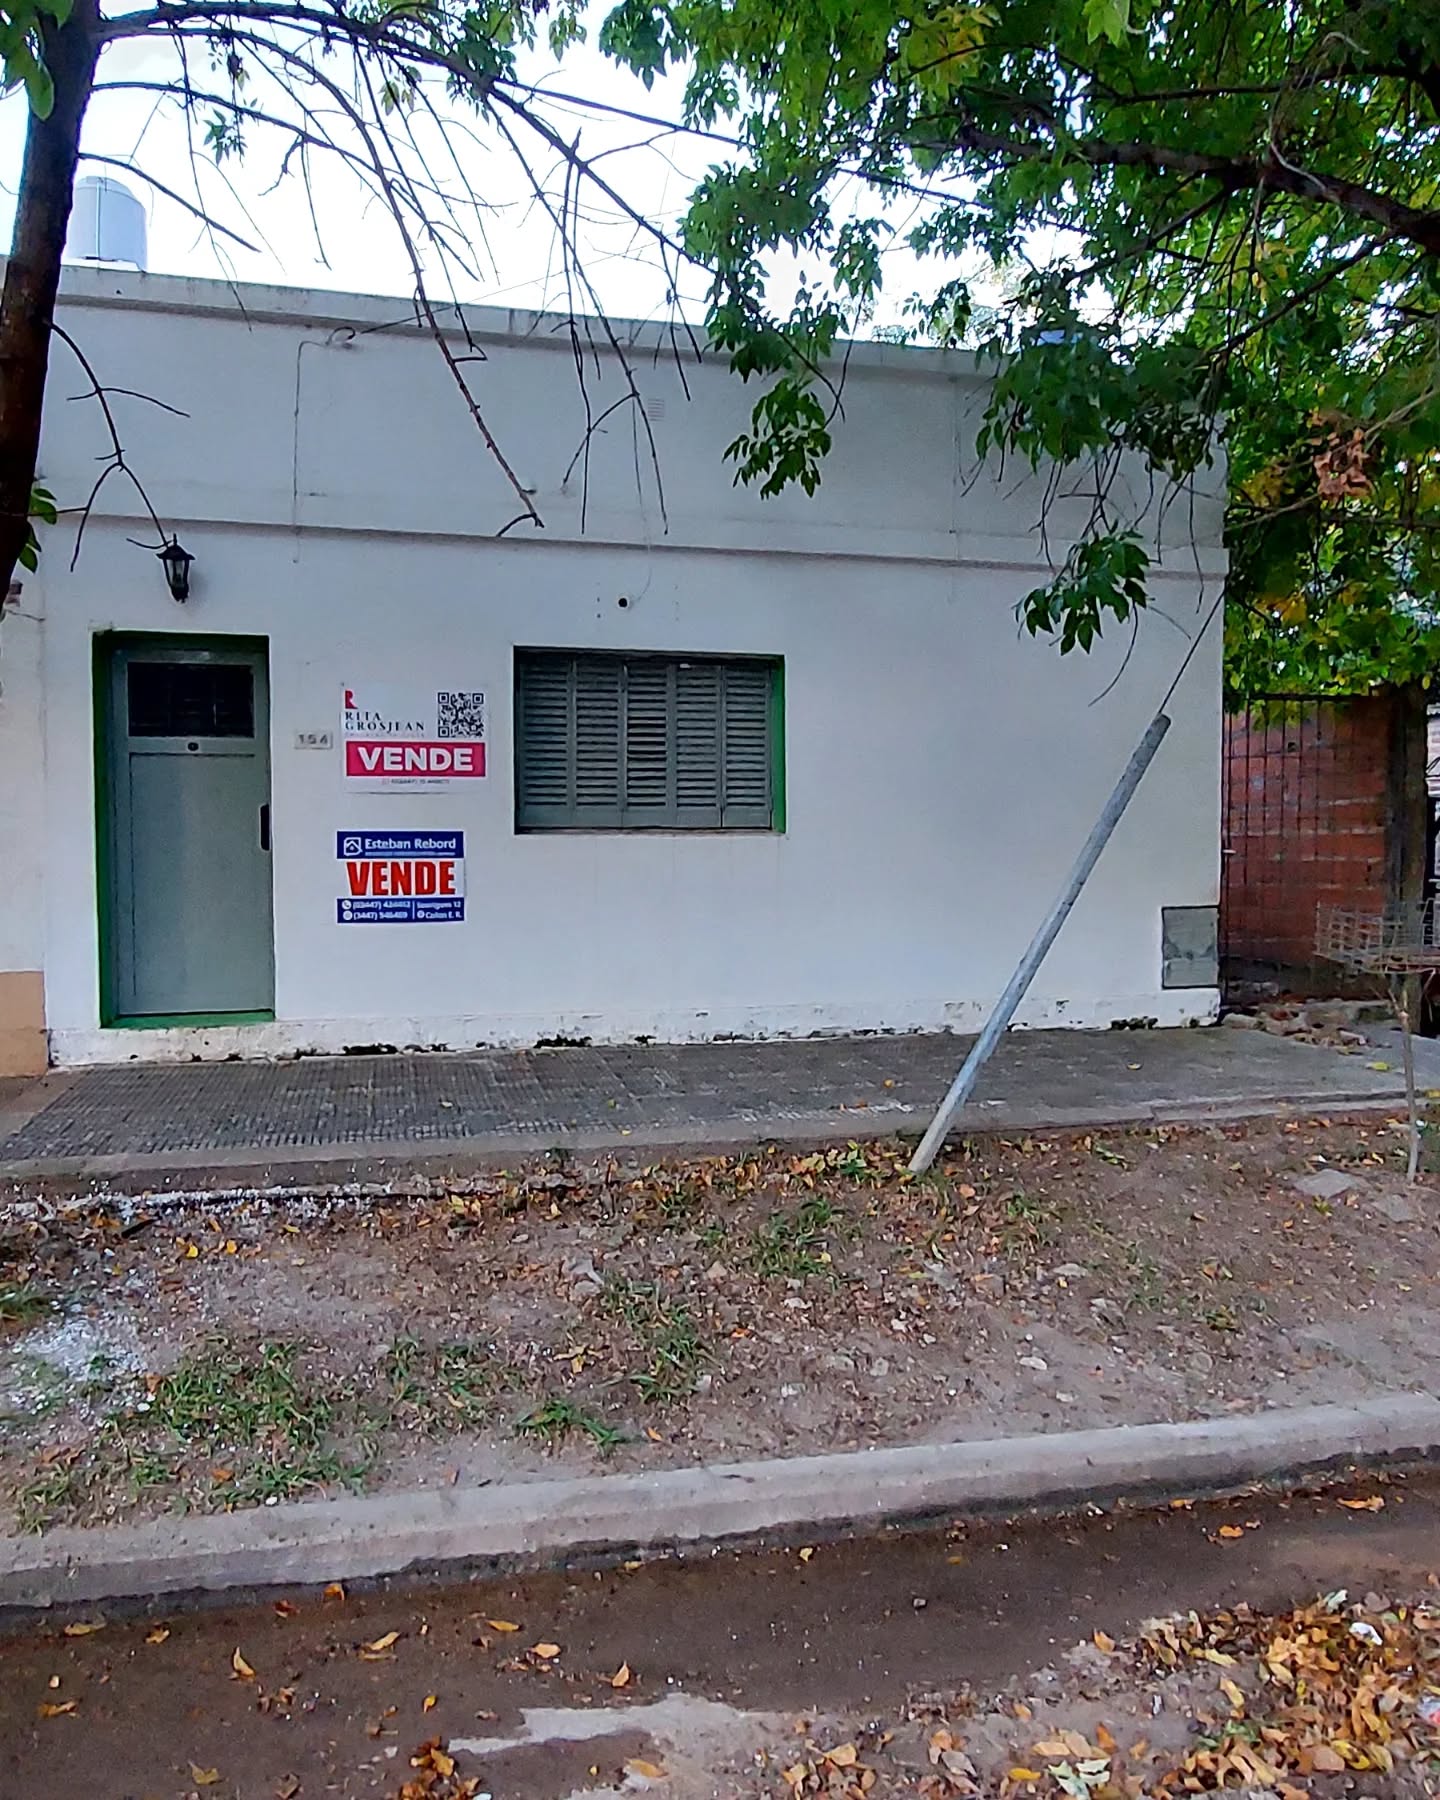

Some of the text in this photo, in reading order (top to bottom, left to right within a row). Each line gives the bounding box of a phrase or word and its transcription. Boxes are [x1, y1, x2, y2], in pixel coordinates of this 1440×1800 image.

[345, 711, 382, 721] RITA
[345, 721, 425, 734] GROSJEAN
[357, 746, 473, 772] VENDE
[365, 838, 456, 849] Esteban Rebord
[346, 861, 456, 896] VENDE
